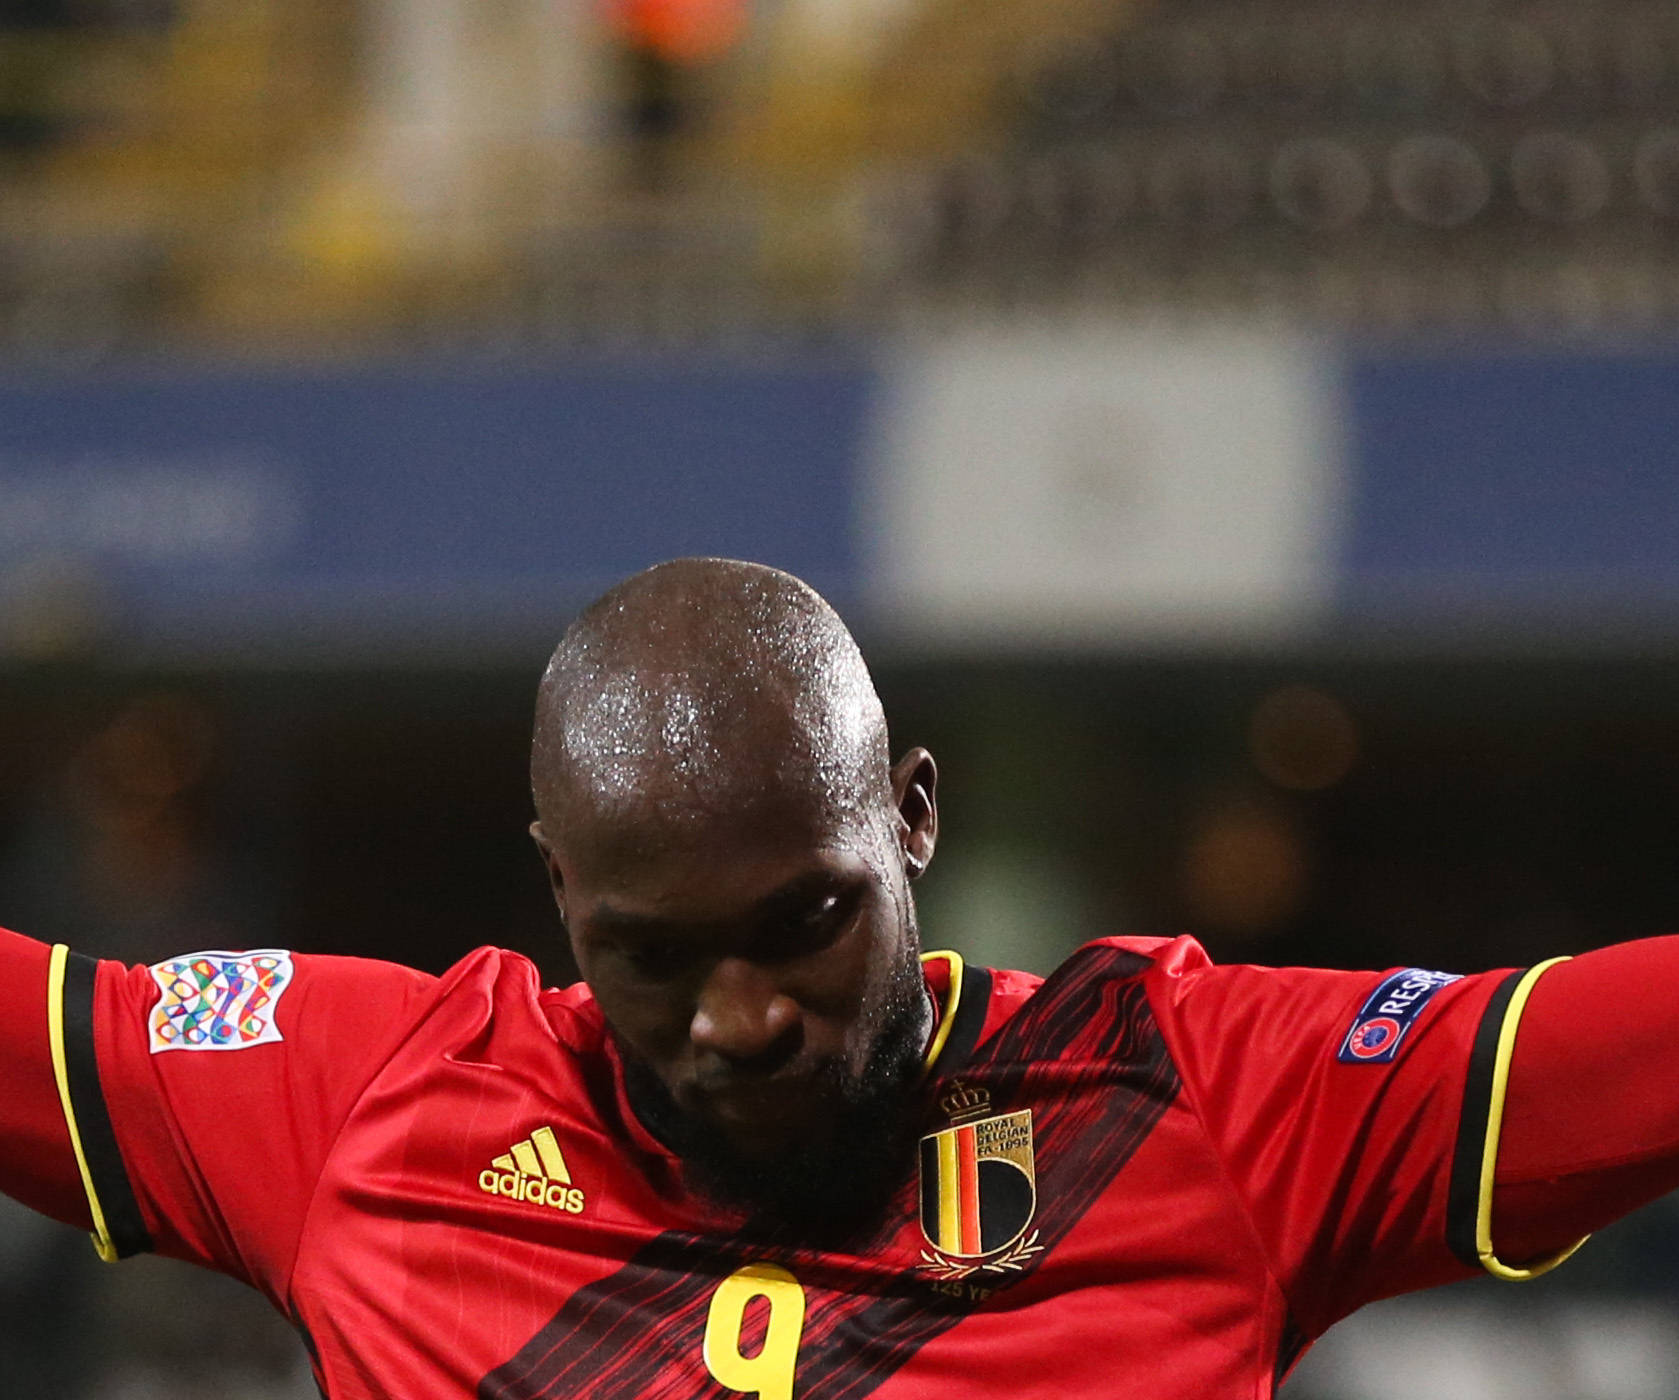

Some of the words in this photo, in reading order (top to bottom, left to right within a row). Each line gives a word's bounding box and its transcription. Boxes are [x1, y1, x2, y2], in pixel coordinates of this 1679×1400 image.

[976, 1118, 1014, 1134] ROYAL
[977, 1127, 1028, 1146] BELGIAN
[478, 1169, 585, 1214] adidas
